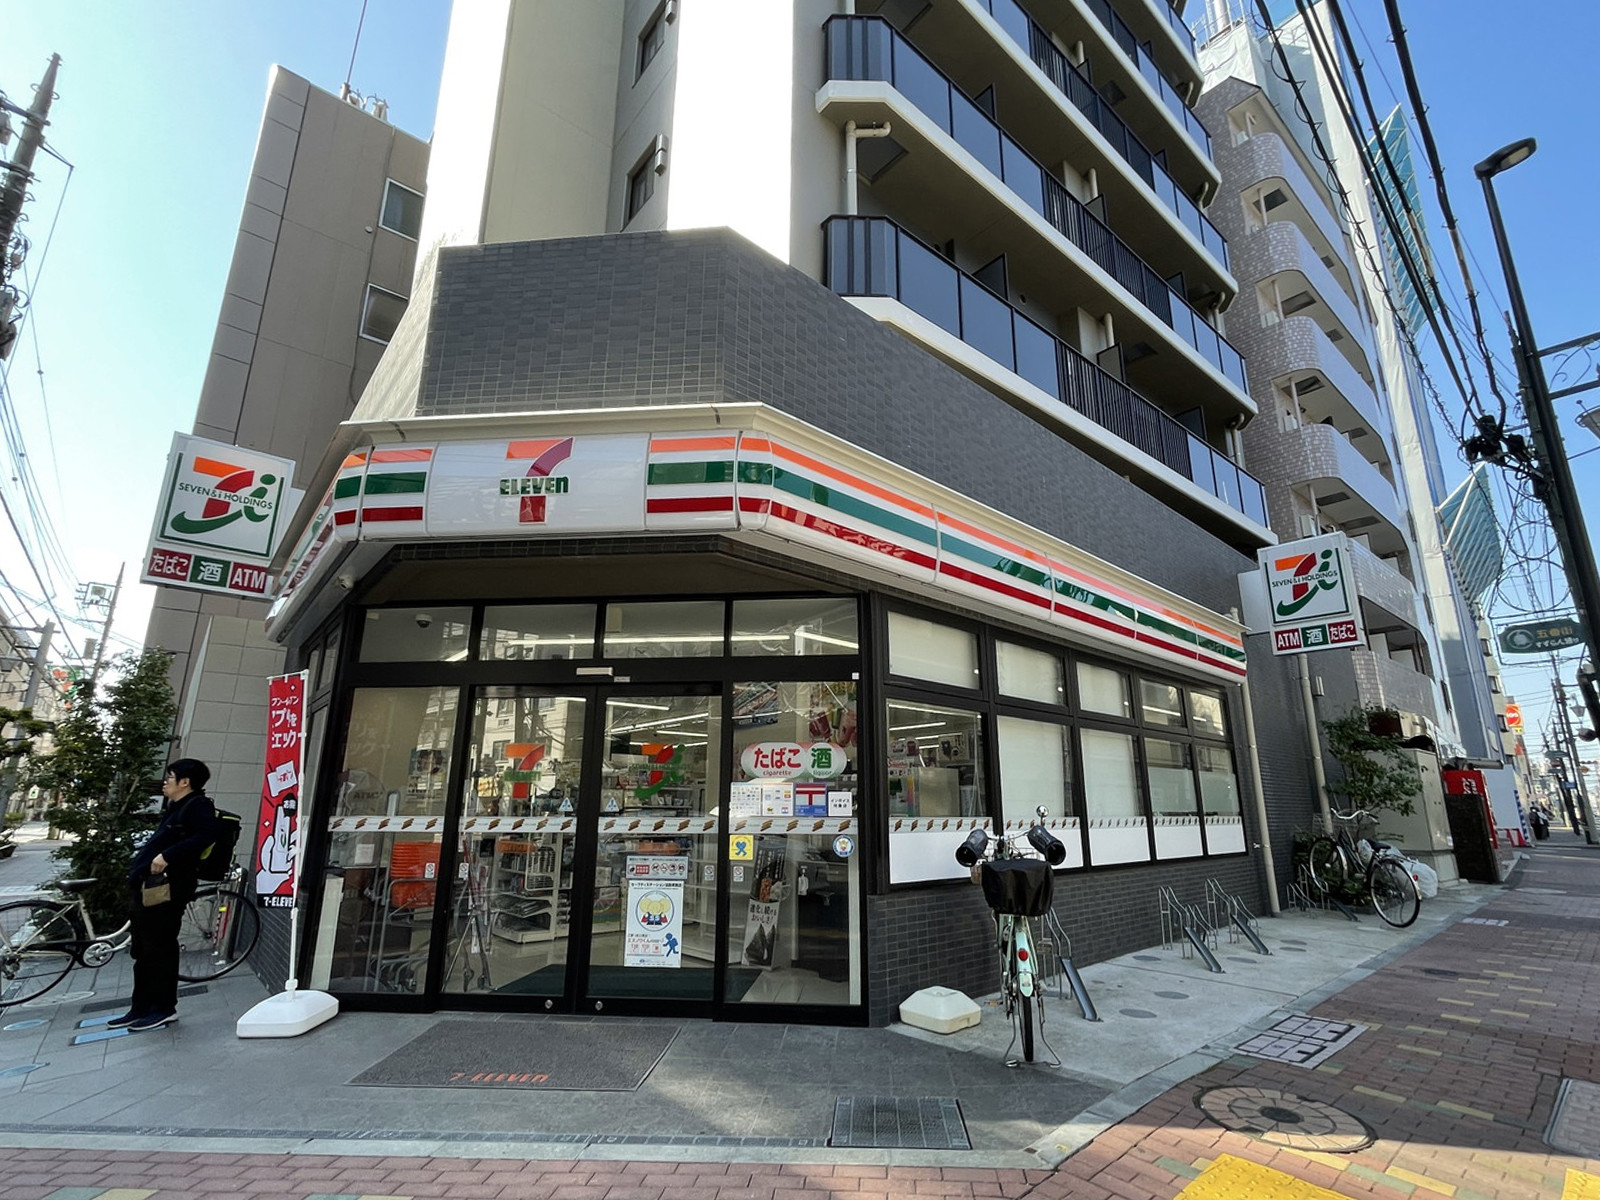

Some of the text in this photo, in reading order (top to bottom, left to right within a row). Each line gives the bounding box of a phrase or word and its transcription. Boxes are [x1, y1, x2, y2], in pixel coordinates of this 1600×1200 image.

[223, 492, 273, 510] HOLDINGS
[150, 553, 266, 590] たばこ 酒 ATM
[1302, 570, 1338, 581] HOLDINGS
[1277, 624, 1357, 649] ATM 酒 たばこ
[754, 747, 833, 769] たばこ 酒
[263, 896, 294, 908] 7-ELEVE
